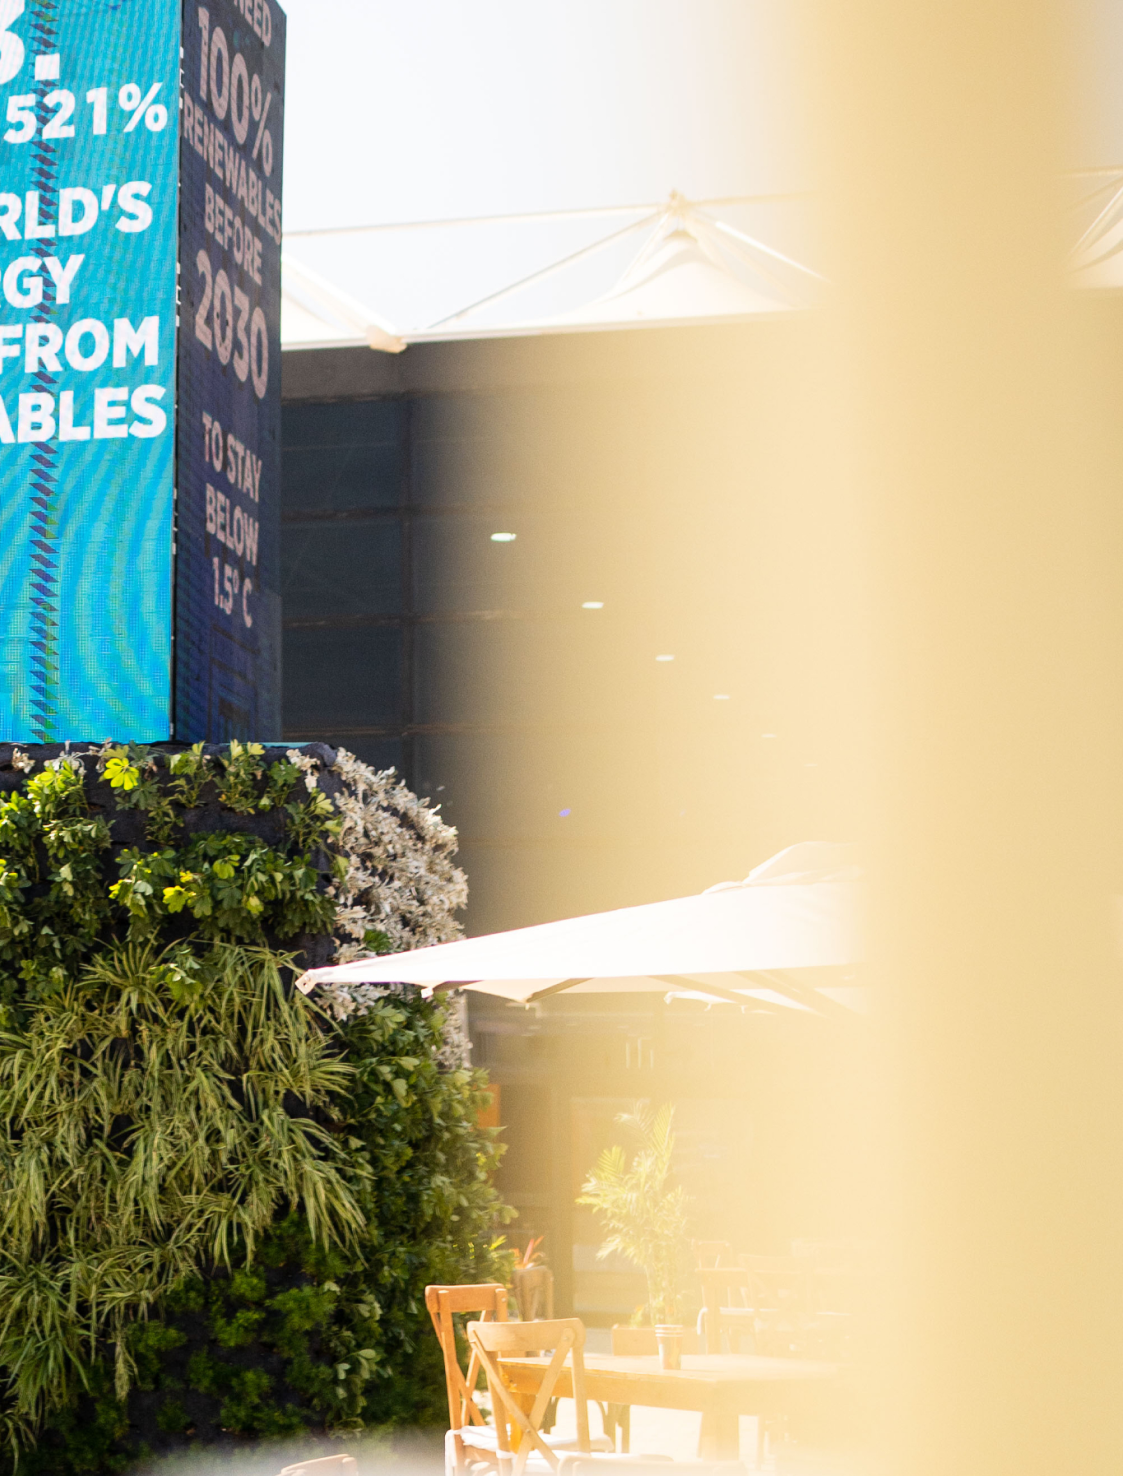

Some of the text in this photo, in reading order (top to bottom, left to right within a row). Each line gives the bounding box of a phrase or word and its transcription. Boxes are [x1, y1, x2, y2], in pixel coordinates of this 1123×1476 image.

[198, 6, 273, 176] 100%
[184, 91, 282, 246] RENEWABLES
[205, 183, 263, 287] BEFORE
[195, 249, 269, 399] 2030
[202, 411, 262, 503] TO STAY
[206, 483, 259, 567] BELOW
